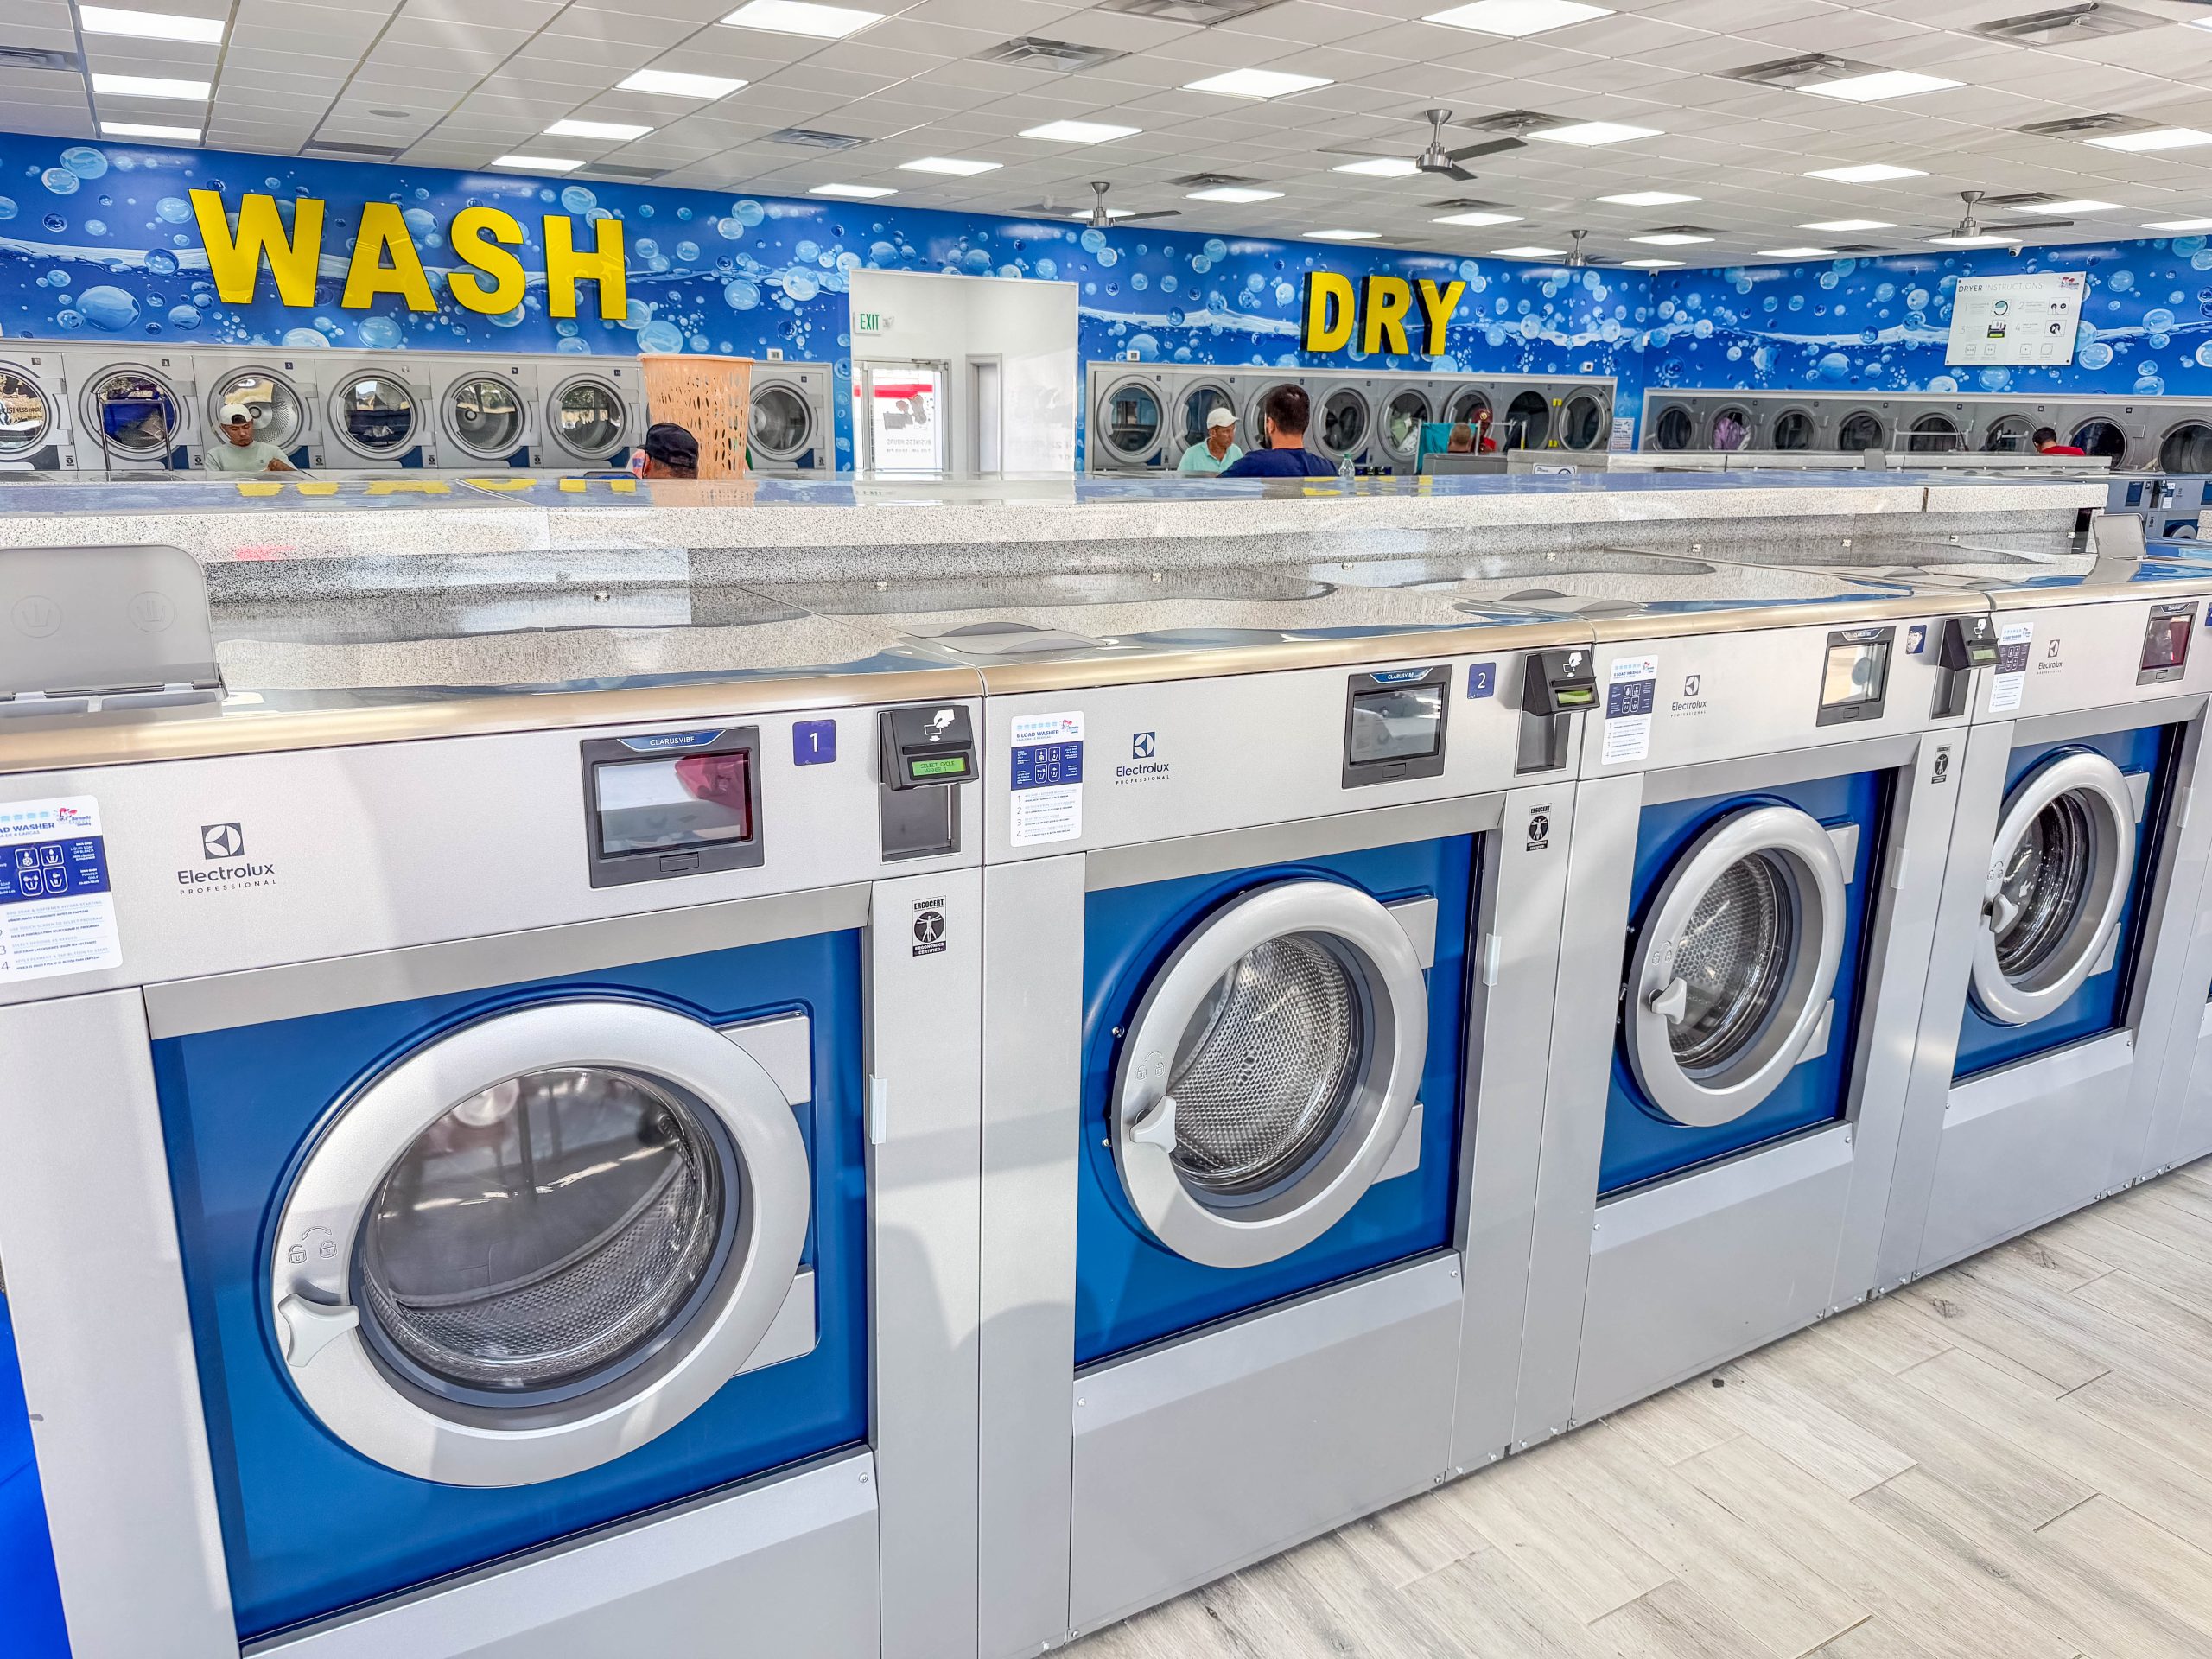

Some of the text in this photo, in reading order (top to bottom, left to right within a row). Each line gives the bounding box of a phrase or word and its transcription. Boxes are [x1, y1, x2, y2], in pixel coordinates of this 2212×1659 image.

[188, 188, 628, 320] WASH
[1958, 282, 2043, 293] DRYER INSTRUCTIONS
[1302, 270, 1466, 356] DRY
[860, 313, 880, 331] EXIT
[1477, 672, 1486, 689] 2
[1672, 700, 1707, 711] Electrolux
[810, 732, 818, 753] 1
[1116, 762, 1170, 777] Electrolux
[1116, 775, 1170, 785] PROFESSIONAL
[13, 822, 55, 832] WASHER
[178, 863, 275, 885] Electrolux
[180, 879, 276, 896] PROFESSIONAL
[914, 899, 944, 910] ERGOCERT
[1, 961, 10, 970] 4
